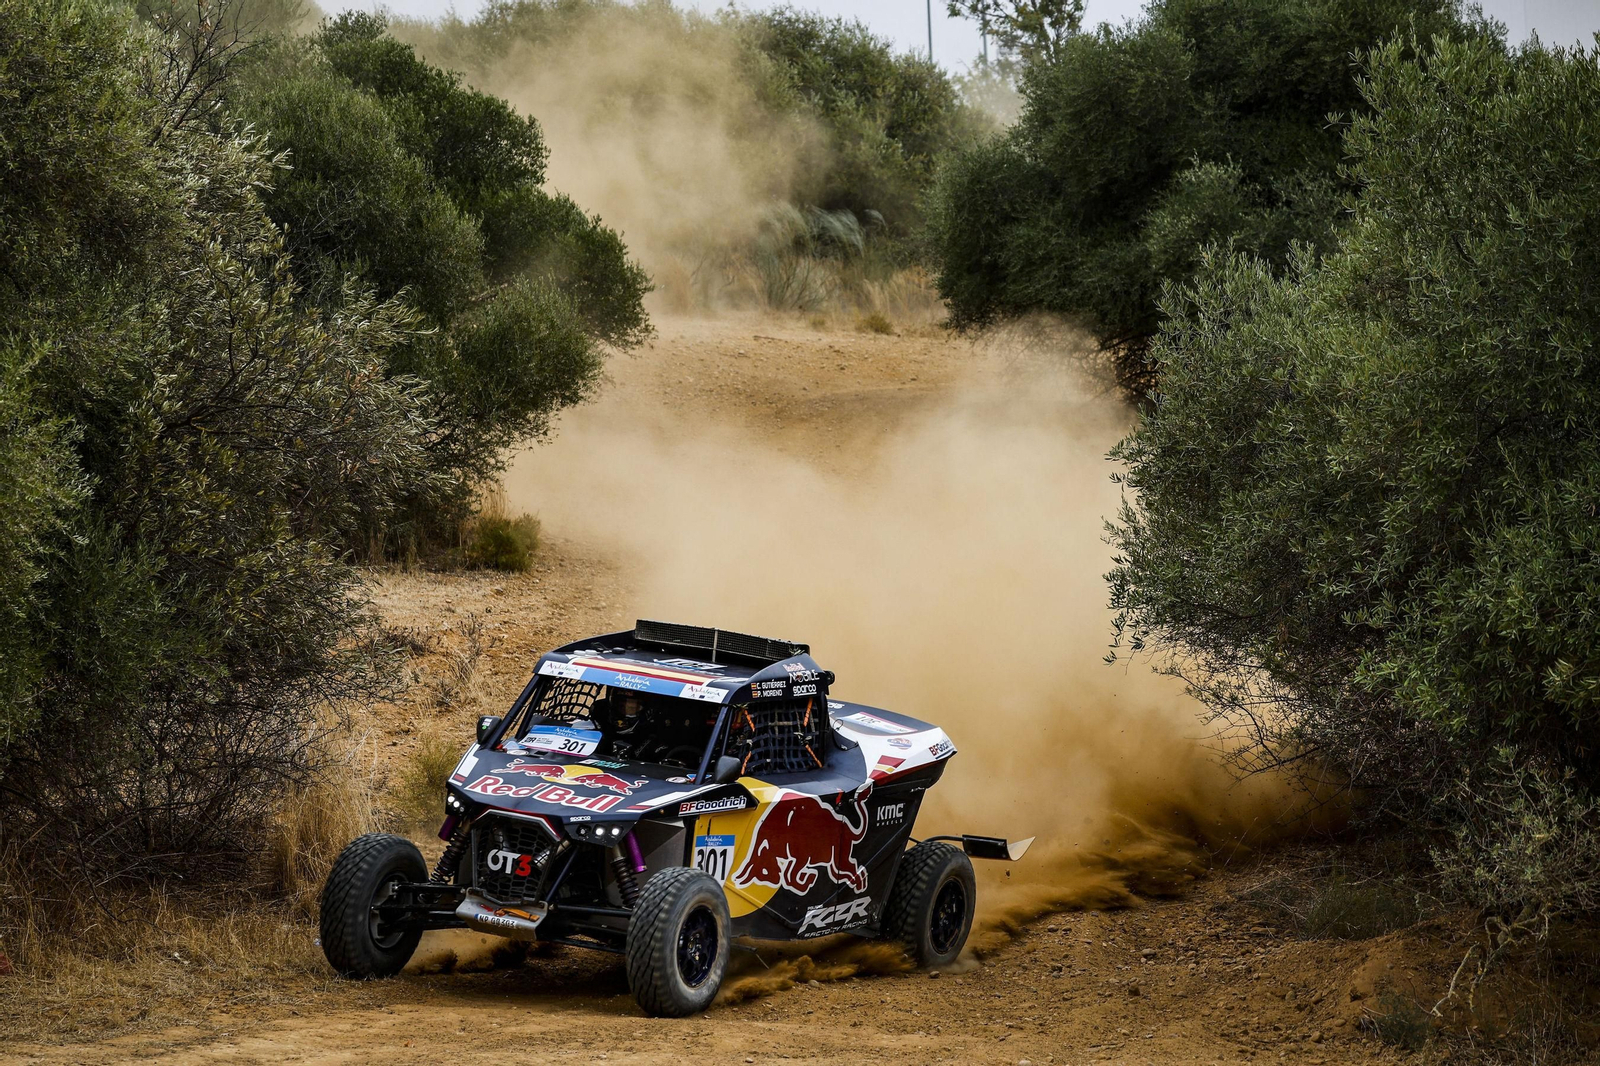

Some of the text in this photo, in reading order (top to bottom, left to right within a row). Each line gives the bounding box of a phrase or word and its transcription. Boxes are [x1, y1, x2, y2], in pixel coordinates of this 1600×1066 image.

[619, 681, 643, 689] RALLY
[762, 678, 786, 689] GUTIÉRREZ
[792, 684, 817, 694] sparco
[763, 689, 783, 698] MORENO
[558, 738, 587, 754] 301
[464, 775, 625, 813] Red Bull
[679, 795, 747, 813] BFGoodrich
[876, 803, 904, 821] KMC
[487, 849, 532, 877] OT3
[697, 848, 728, 880] 301
[841, 918, 868, 931] RACING
